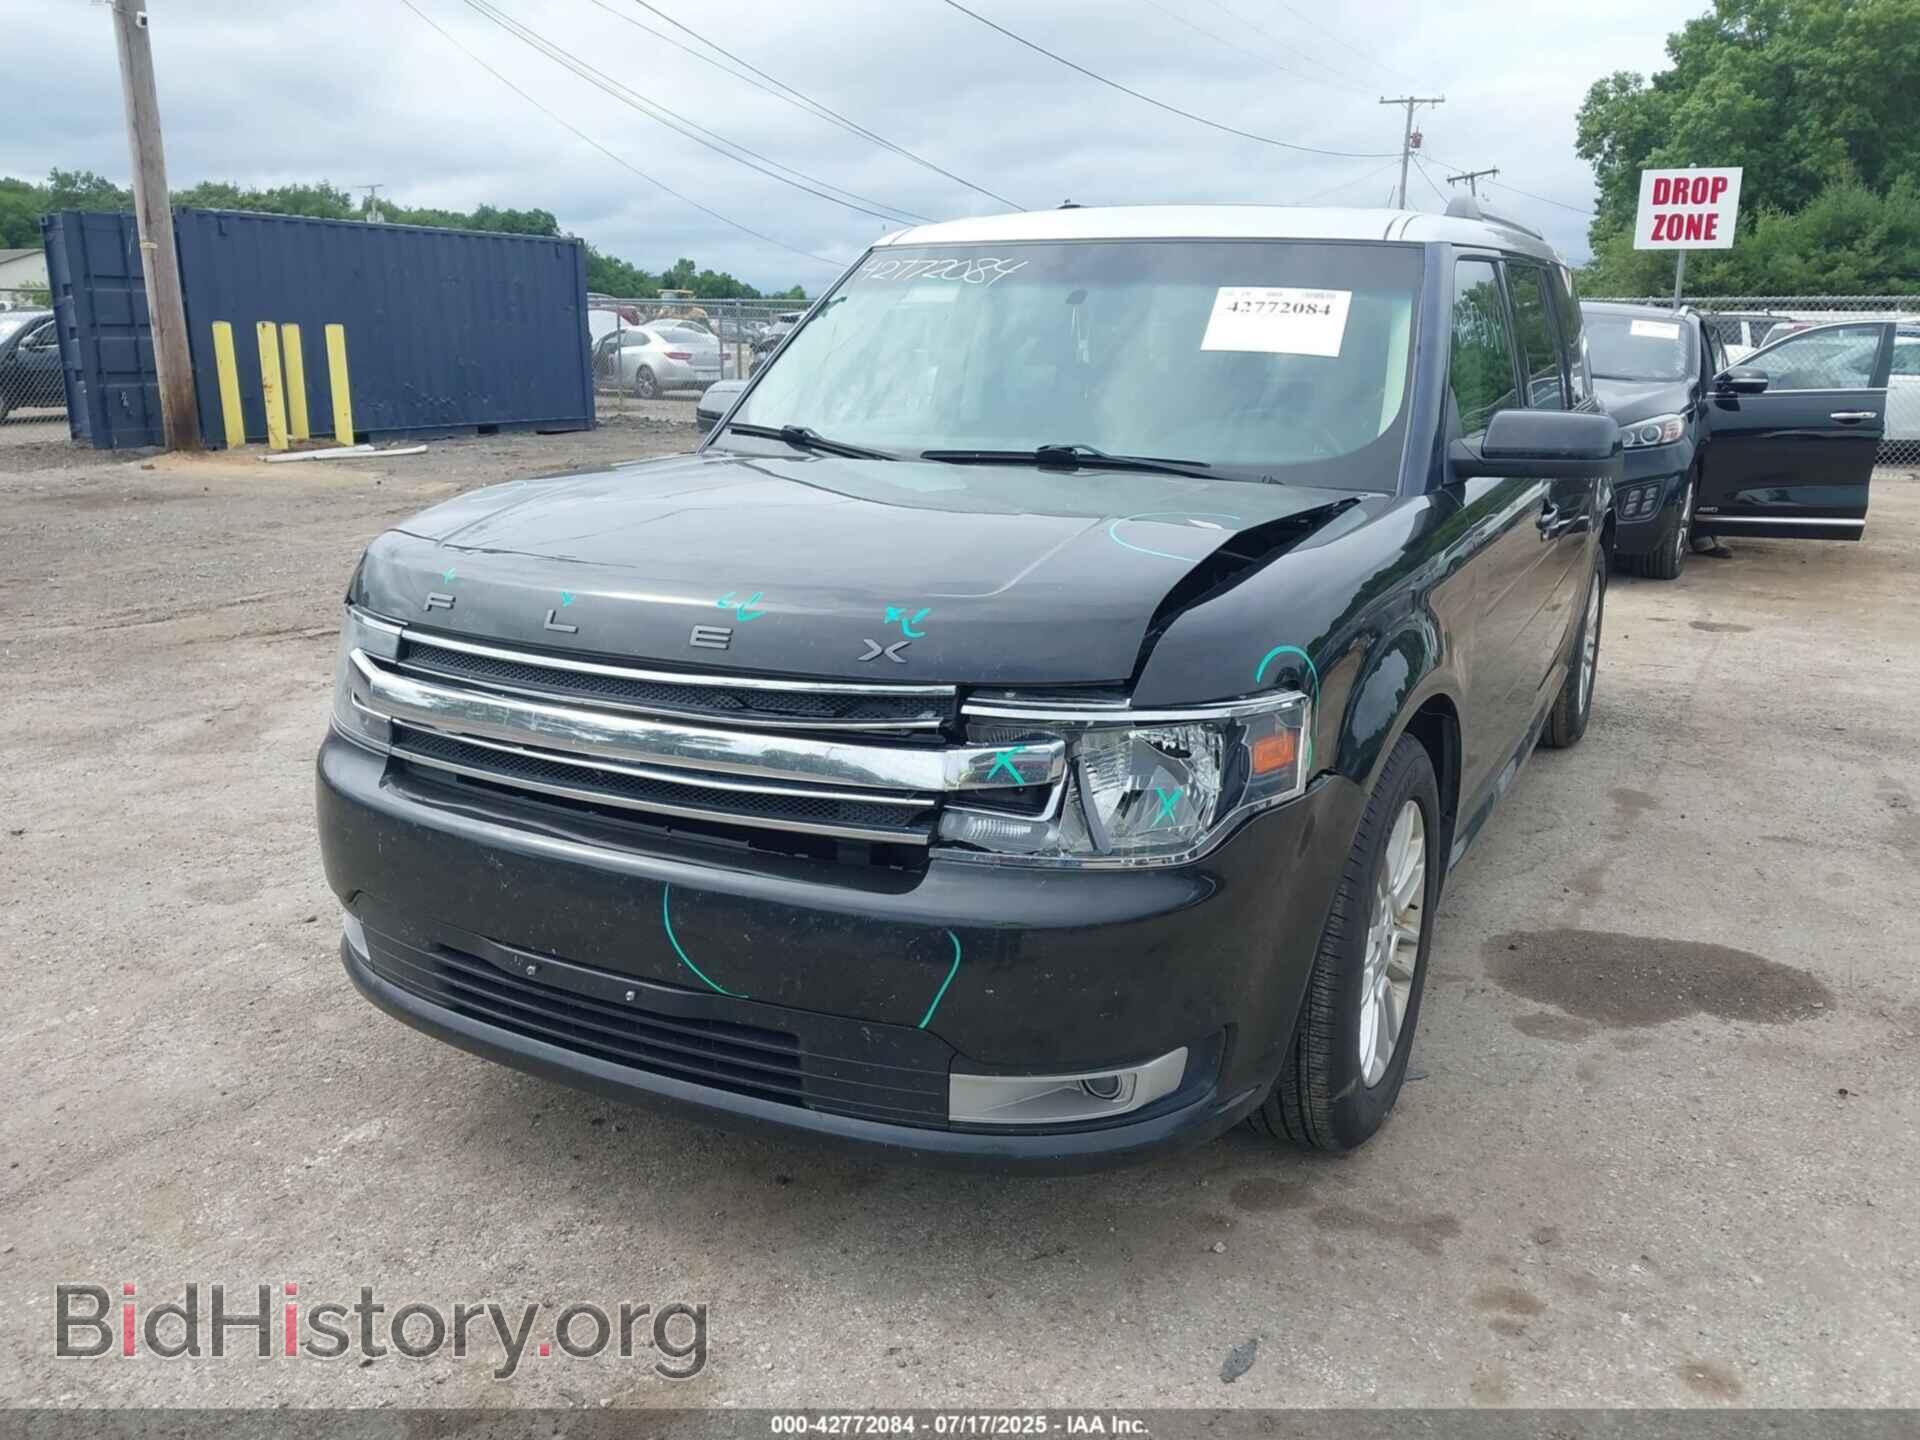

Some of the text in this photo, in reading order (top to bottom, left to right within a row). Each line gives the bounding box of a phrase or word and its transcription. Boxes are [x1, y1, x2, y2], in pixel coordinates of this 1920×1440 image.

[1652, 176, 1729, 206] DROP
[1651, 213, 1719, 242] ZONE
[861, 256, 1031, 288] 42772084
[1225, 301, 1332, 316] 42772084
[423, 591, 912, 664] FLEX
